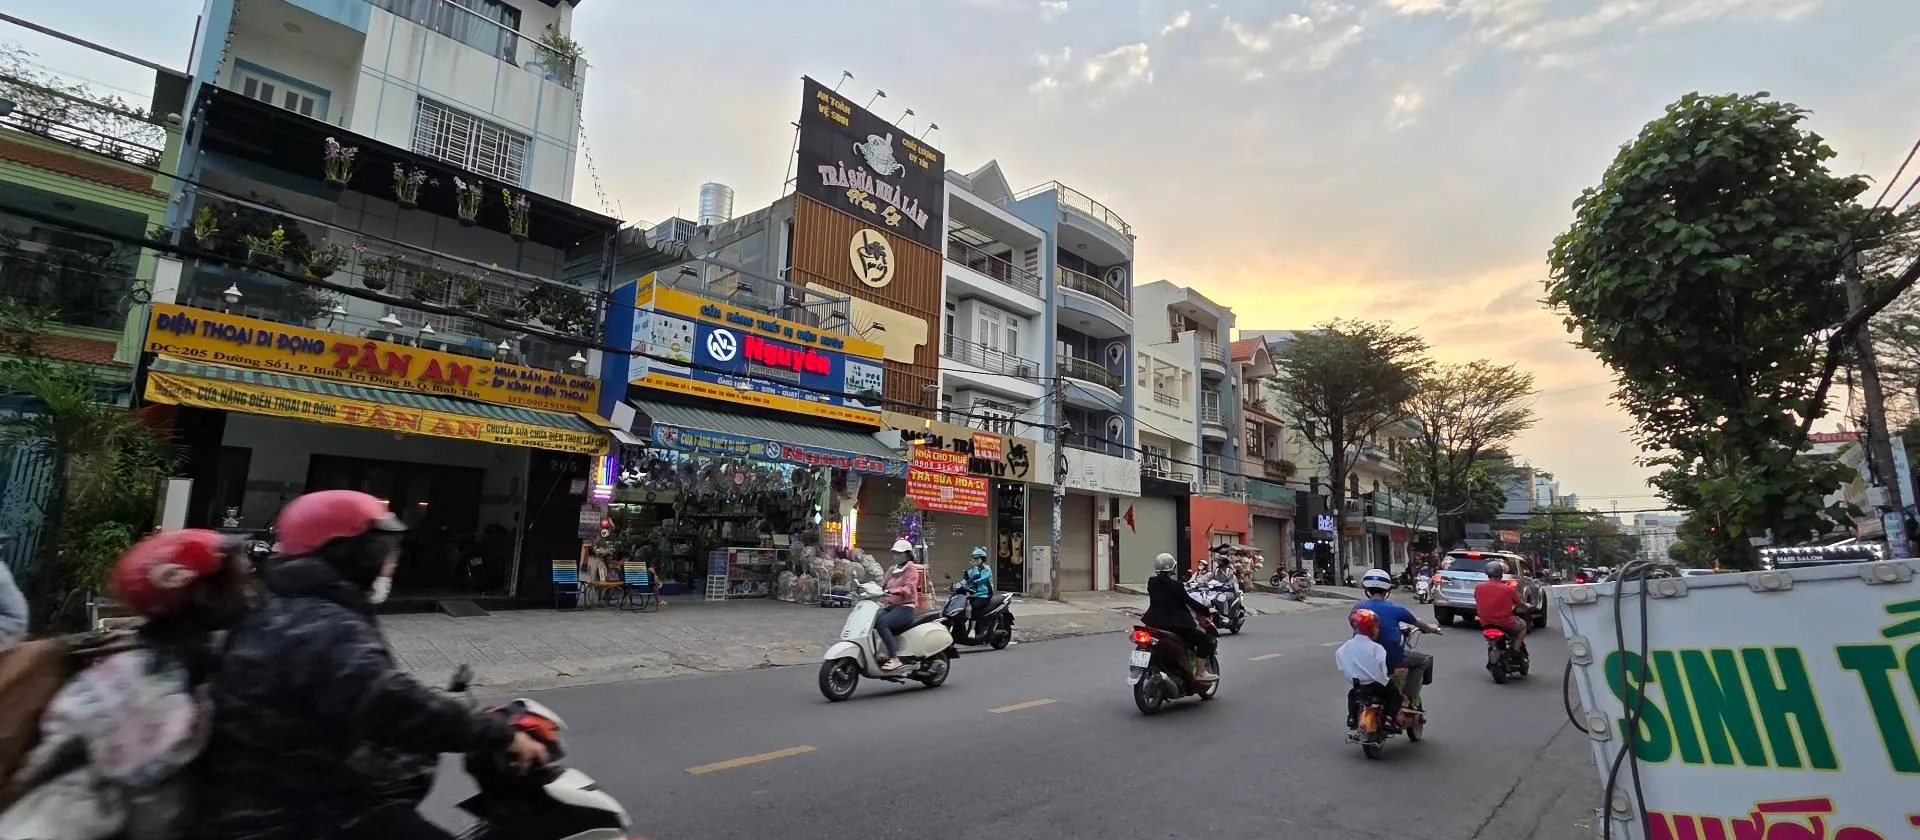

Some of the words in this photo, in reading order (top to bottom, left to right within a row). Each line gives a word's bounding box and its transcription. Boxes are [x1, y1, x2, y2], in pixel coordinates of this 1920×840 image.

[816, 90, 829, 103] AN
[818, 104, 830, 118] VỆ
[831, 111, 849, 127] SINH
[818, 160, 849, 187] TRÀ
[875, 179, 901, 210] NHÀ
[901, 195, 929, 230] LÀM
[156, 312, 197, 336] ĐIỆN
[203, 321, 252, 346] THOẠI
[257, 330, 273, 347] DI
[331, 342, 412, 378] TÂN
[418, 358, 472, 388] AN
[744, 335, 831, 376] Nguyên
[213, 351, 261, 367] Đường
[312, 366, 343, 378] Bình
[347, 371, 366, 382] Trị
[369, 374, 400, 388] Đông
[432, 384, 457, 395] Bình
[460, 387, 480, 398] Tân
[494, 366, 517, 378] MUA
[520, 370, 542, 381] BÁN
[220, 388, 248, 405] HÀNG
[340, 405, 423, 431] TÂN
[430, 417, 483, 440] AN
[486, 423, 514, 435] CHUYÊN
[781, 445, 885, 473] Nguyên
[915, 449, 932, 459] NHÀ
[932, 452, 948, 461] CHO
[911, 471, 931, 481] TRÀ
[955, 477, 974, 488] HOA
[1797, 554, 1824, 562] SALON
[1604, 646, 1839, 770] SINH
[1834, 600, 1920, 774] T
